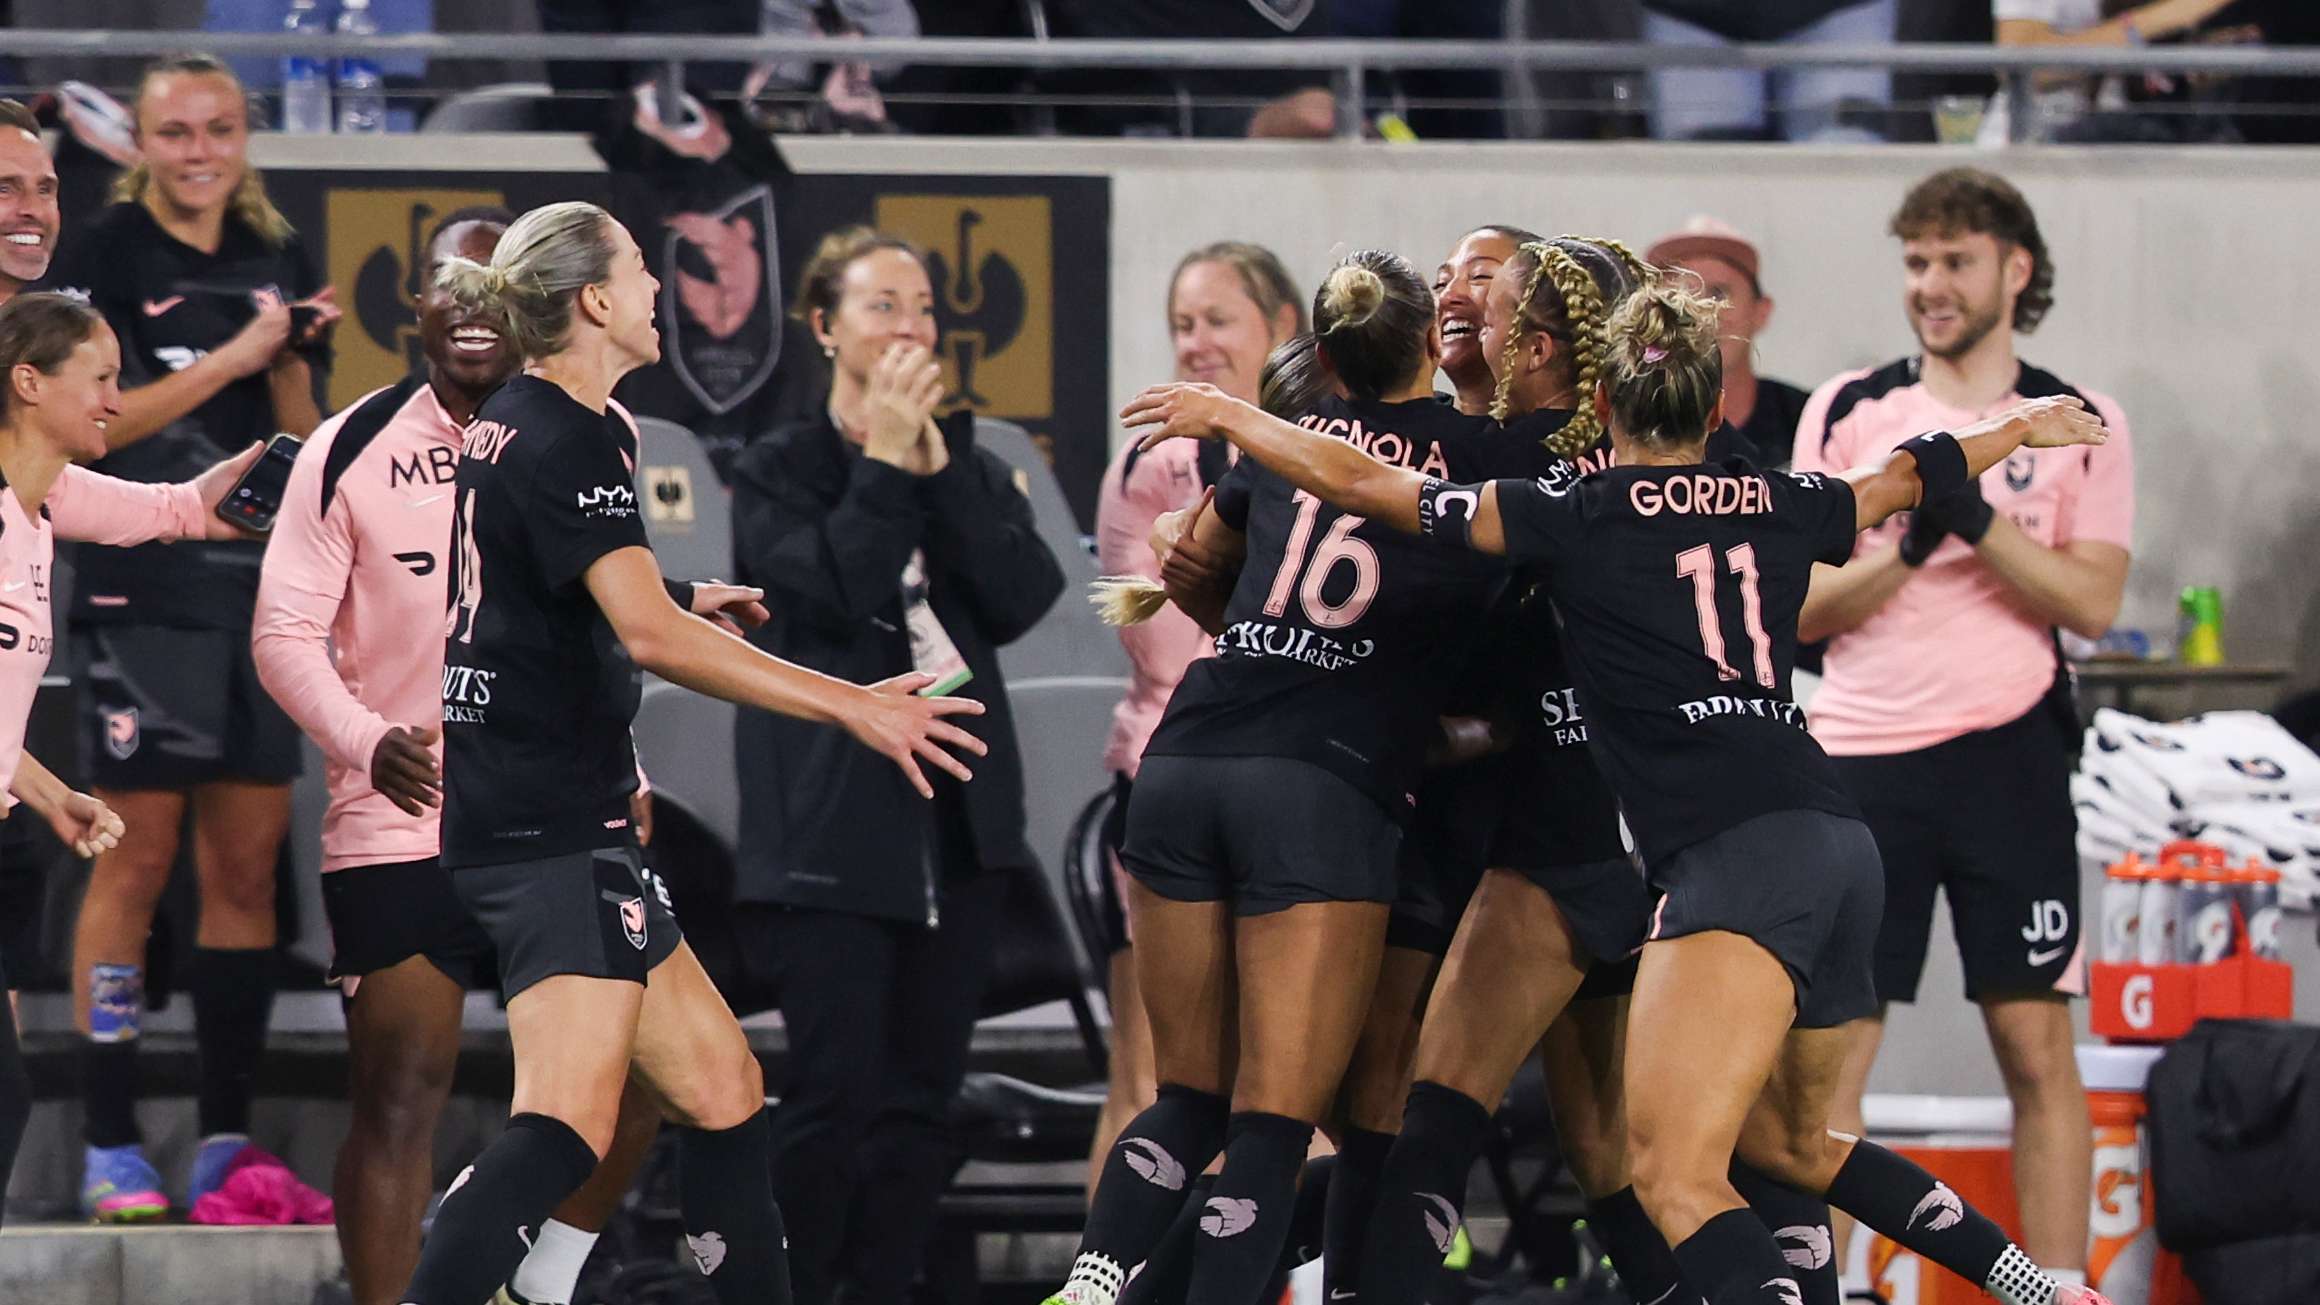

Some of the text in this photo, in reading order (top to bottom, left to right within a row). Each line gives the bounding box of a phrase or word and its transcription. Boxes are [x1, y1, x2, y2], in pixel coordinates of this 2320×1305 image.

[391, 446, 457, 489] MB
[577, 485, 634, 508] NYX
[1434, 490, 1478, 521] C
[1630, 474, 1773, 517] GORDEN
[1420, 499, 1434, 536] CITY
[1262, 487, 1380, 629] 16
[1675, 541, 1776, 689] 11
[441, 704, 485, 723] RKET
[2022, 899, 2069, 942] JD
[2120, 974, 2153, 1030] G
